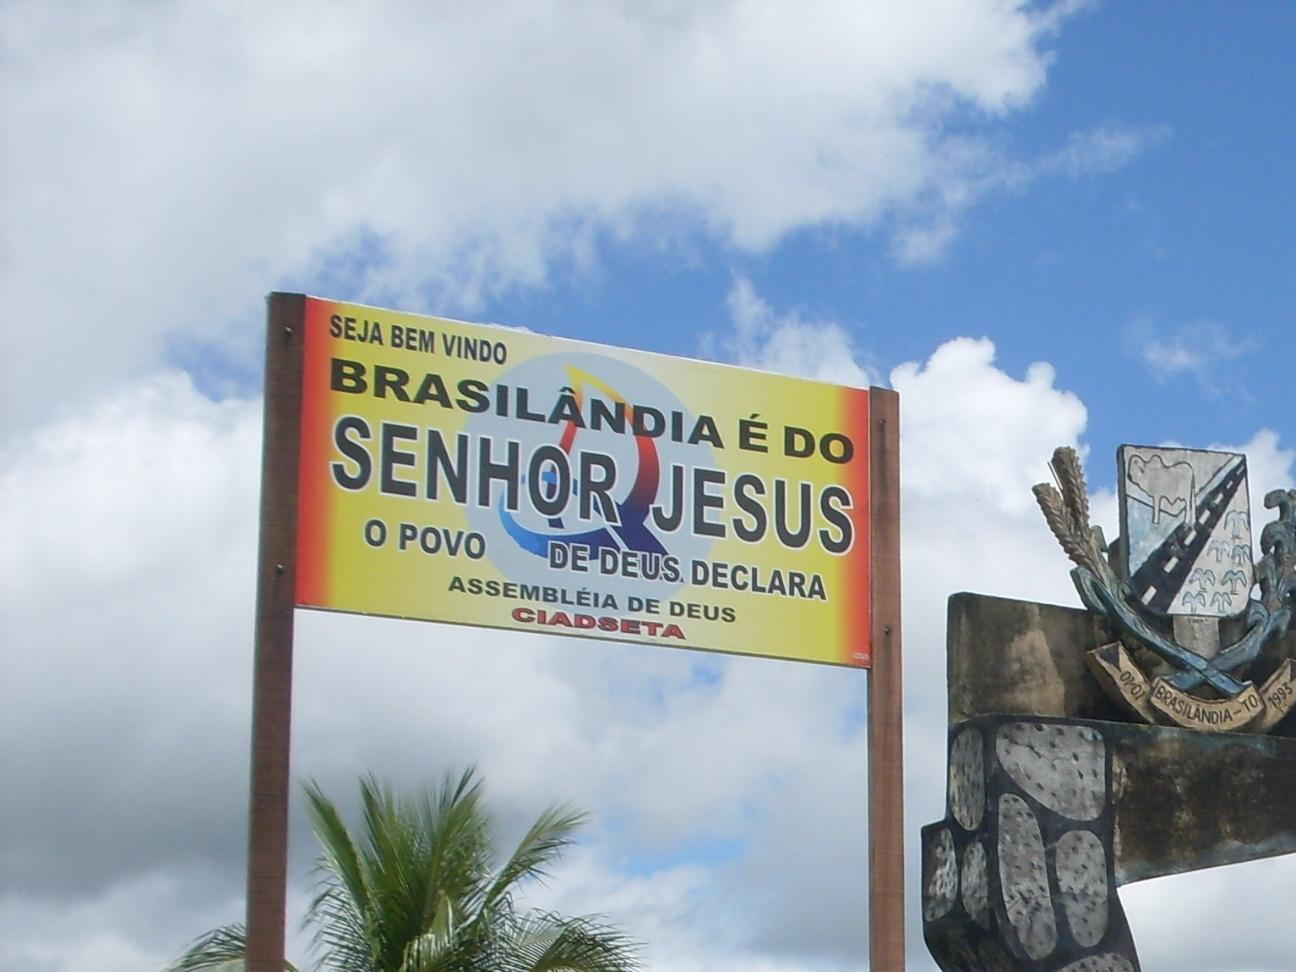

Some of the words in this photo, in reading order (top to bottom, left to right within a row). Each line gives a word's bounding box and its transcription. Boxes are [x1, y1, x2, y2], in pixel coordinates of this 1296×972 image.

[330, 314, 383, 346] SEJA
[391, 324, 435, 354] BEM
[442, 333, 507, 365] VINDO
[330, 357, 725, 449] BRASILÂNDIA
[738, 413, 770, 454] É
[783, 426, 855, 464] DO
[332, 416, 620, 526] SENHOR
[653, 465, 854, 555] JESUS
[364, 519, 387, 549] O
[399, 526, 486, 560] POVO
[550, 542, 590, 573] DE
[692, 560, 827, 601] DECLARA
[448, 575, 620, 612] ASSEMBLÉIA
[628, 595, 660, 616] DE
[669, 600, 737, 624] DEUS
[511, 607, 688, 641] CIADSETA
